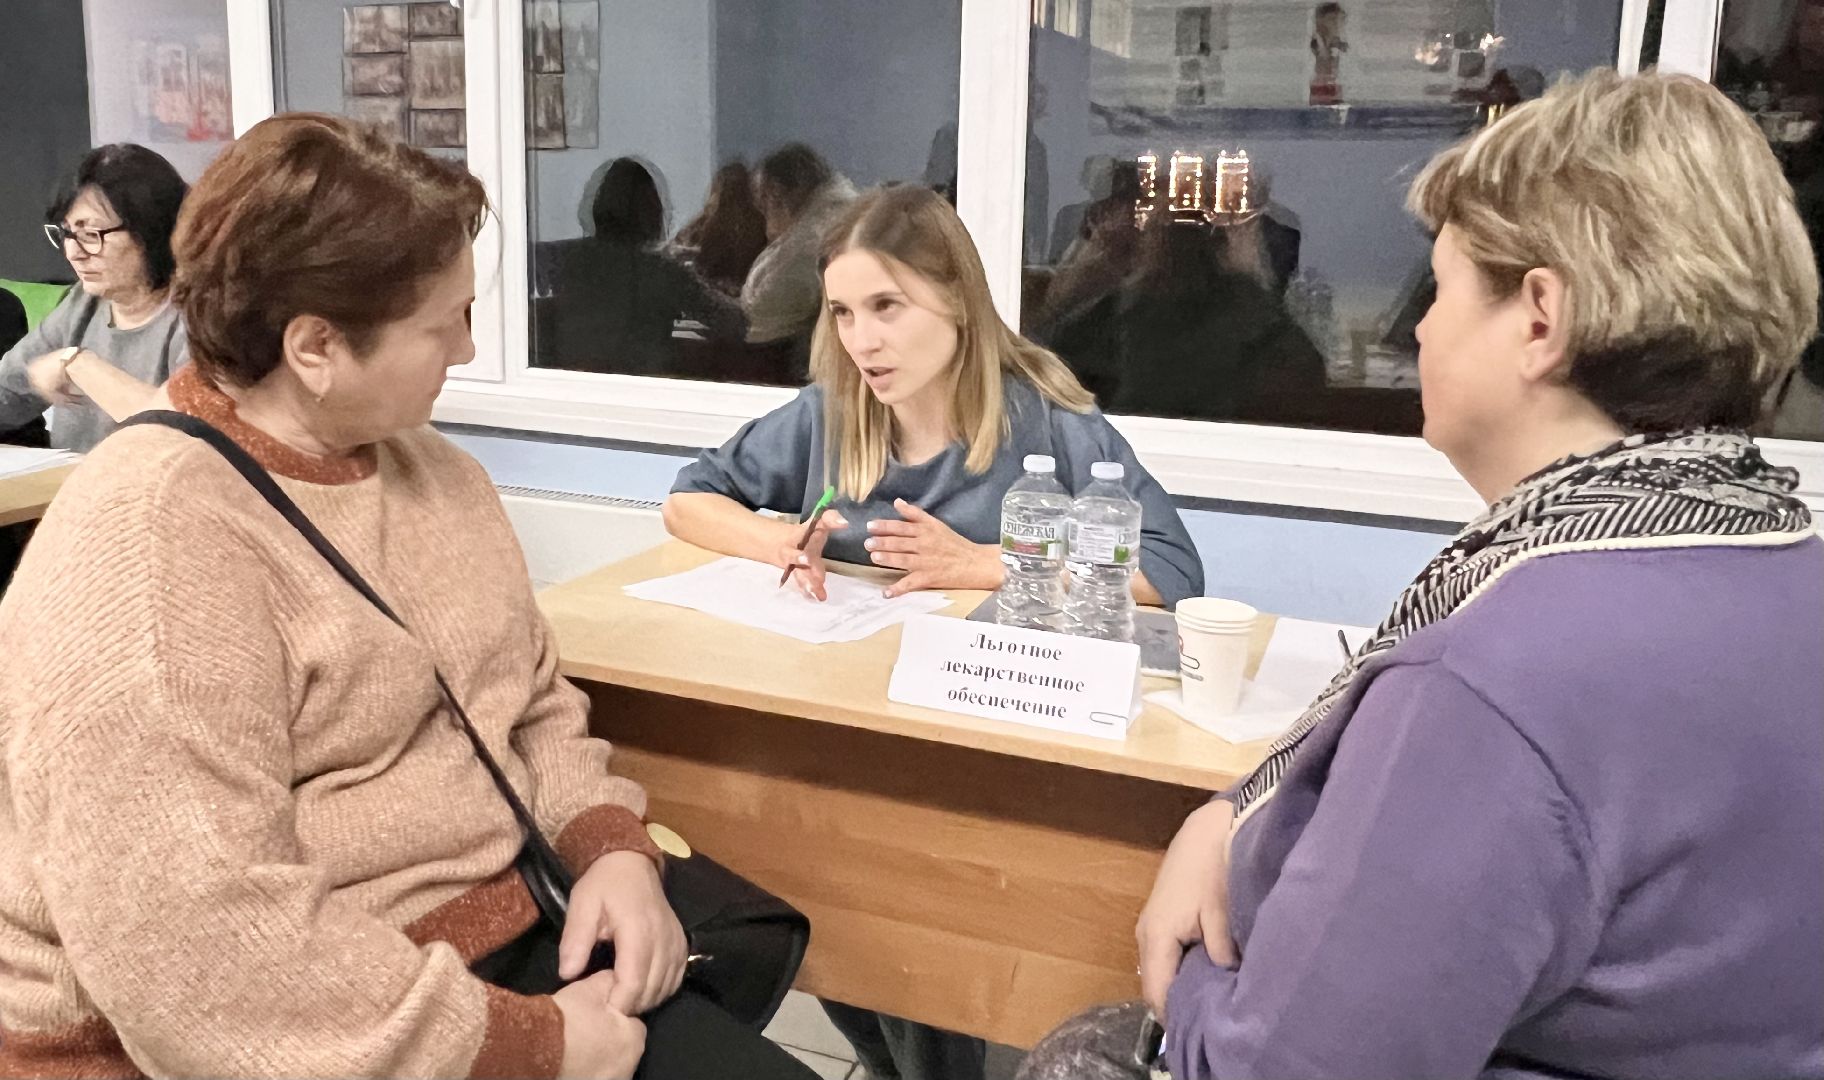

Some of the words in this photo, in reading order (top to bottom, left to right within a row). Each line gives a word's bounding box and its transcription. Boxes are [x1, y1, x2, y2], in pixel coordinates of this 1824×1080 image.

[970, 632, 1062, 661] Льготное
[940, 660, 1085, 693] лекарственное
[947, 686, 1067, 719] обеспечение
